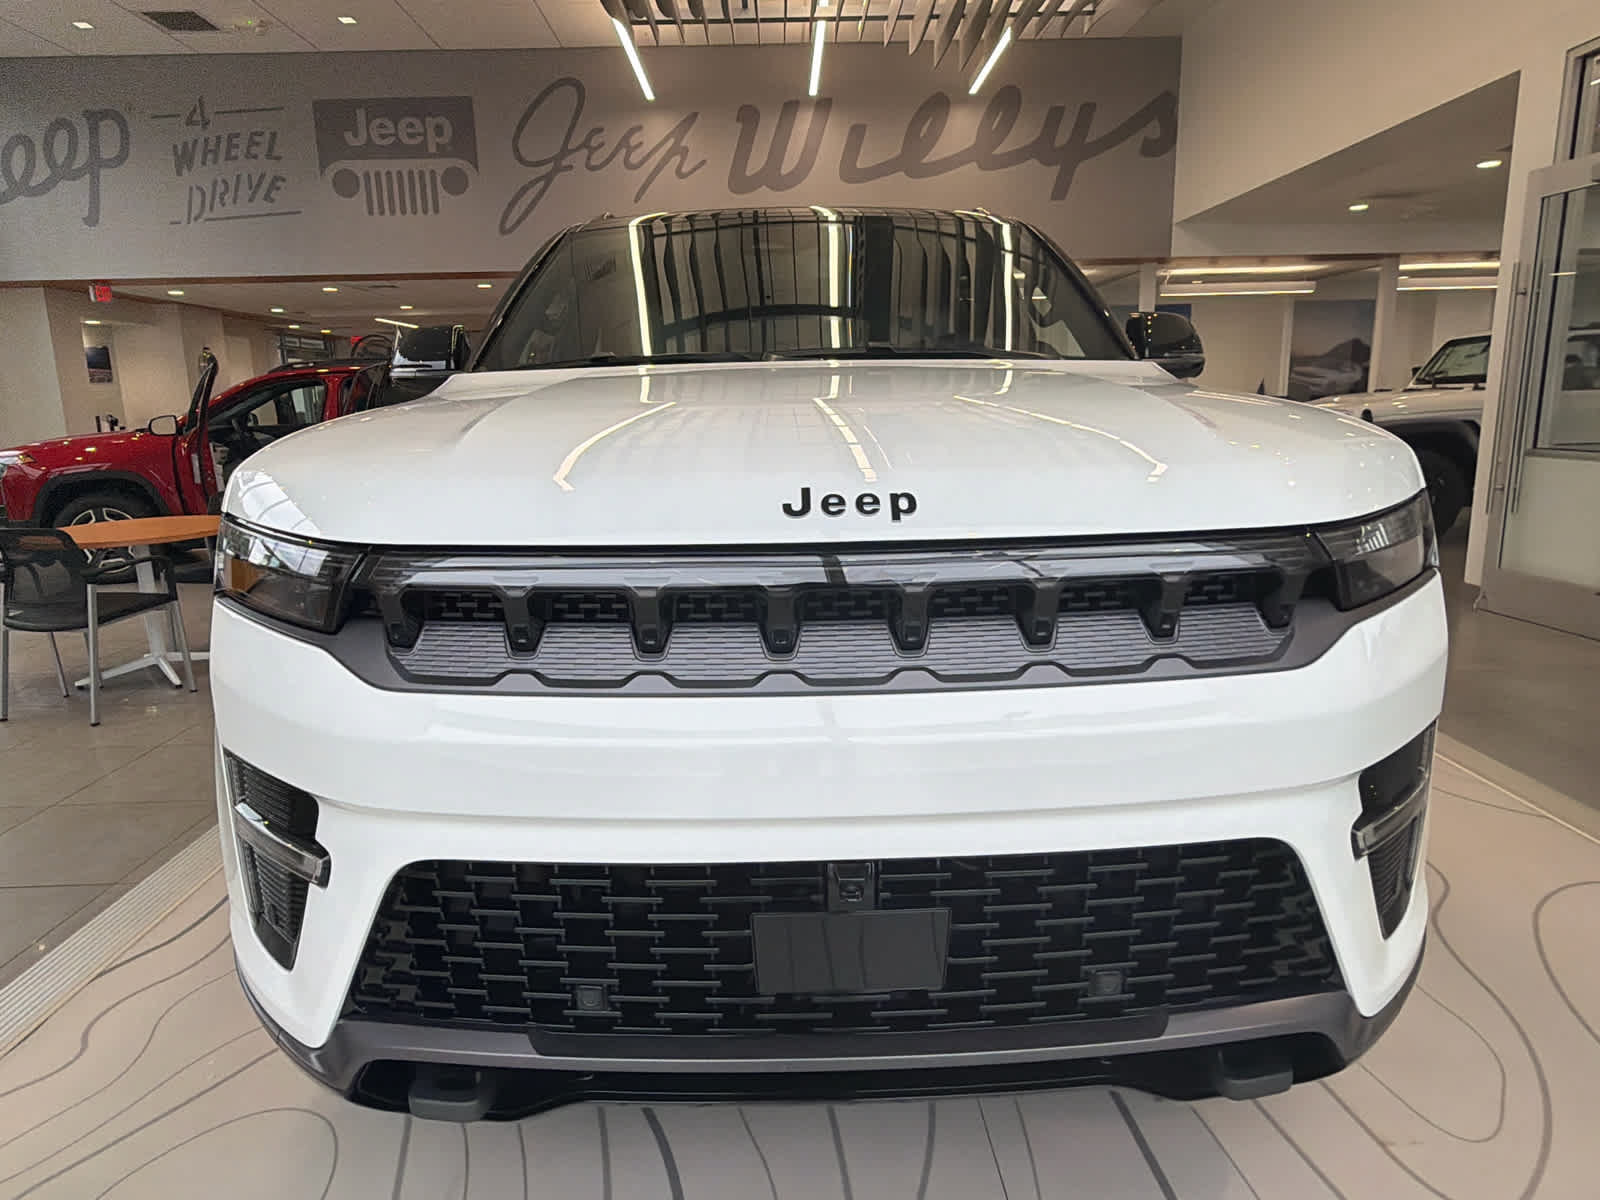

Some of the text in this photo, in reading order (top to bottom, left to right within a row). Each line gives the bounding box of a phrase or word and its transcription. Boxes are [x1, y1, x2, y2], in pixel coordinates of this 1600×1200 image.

[185, 96, 211, 129] 4
[344, 108, 452, 153] Jeep
[0, 108, 131, 228] eep
[172, 130, 283, 177] WHEEL
[499, 76, 1177, 236] Jeep Willys
[186, 172, 286, 225] DRIVE
[782, 487, 917, 522] Jeep
